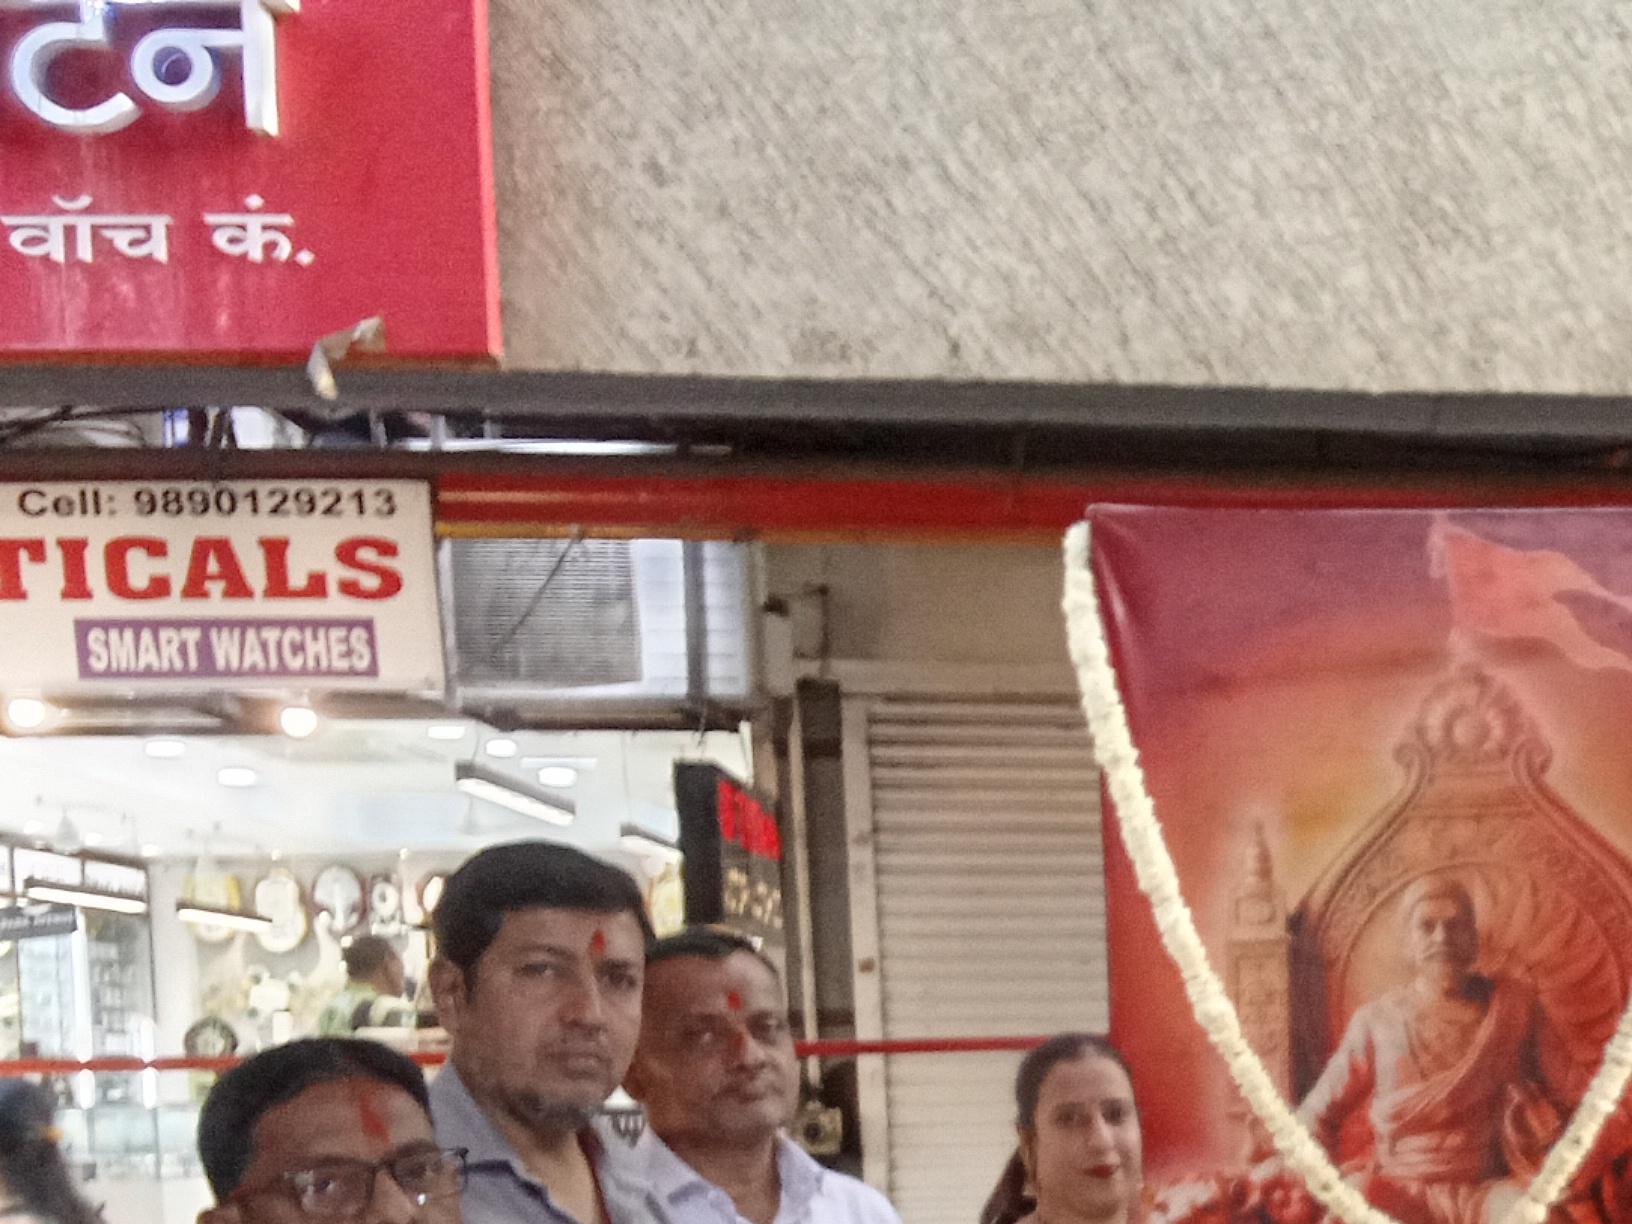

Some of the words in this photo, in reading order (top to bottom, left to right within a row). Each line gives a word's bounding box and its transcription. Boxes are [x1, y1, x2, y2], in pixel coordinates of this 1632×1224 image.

[0, 194, 173, 264] वॉच
[203, 193, 316, 266] कं.
[17, 487, 117, 518] Cell:
[134, 487, 398, 518] 9890129213
[87, 625, 202, 673] SMART
[210, 625, 372, 673] WATCHES
